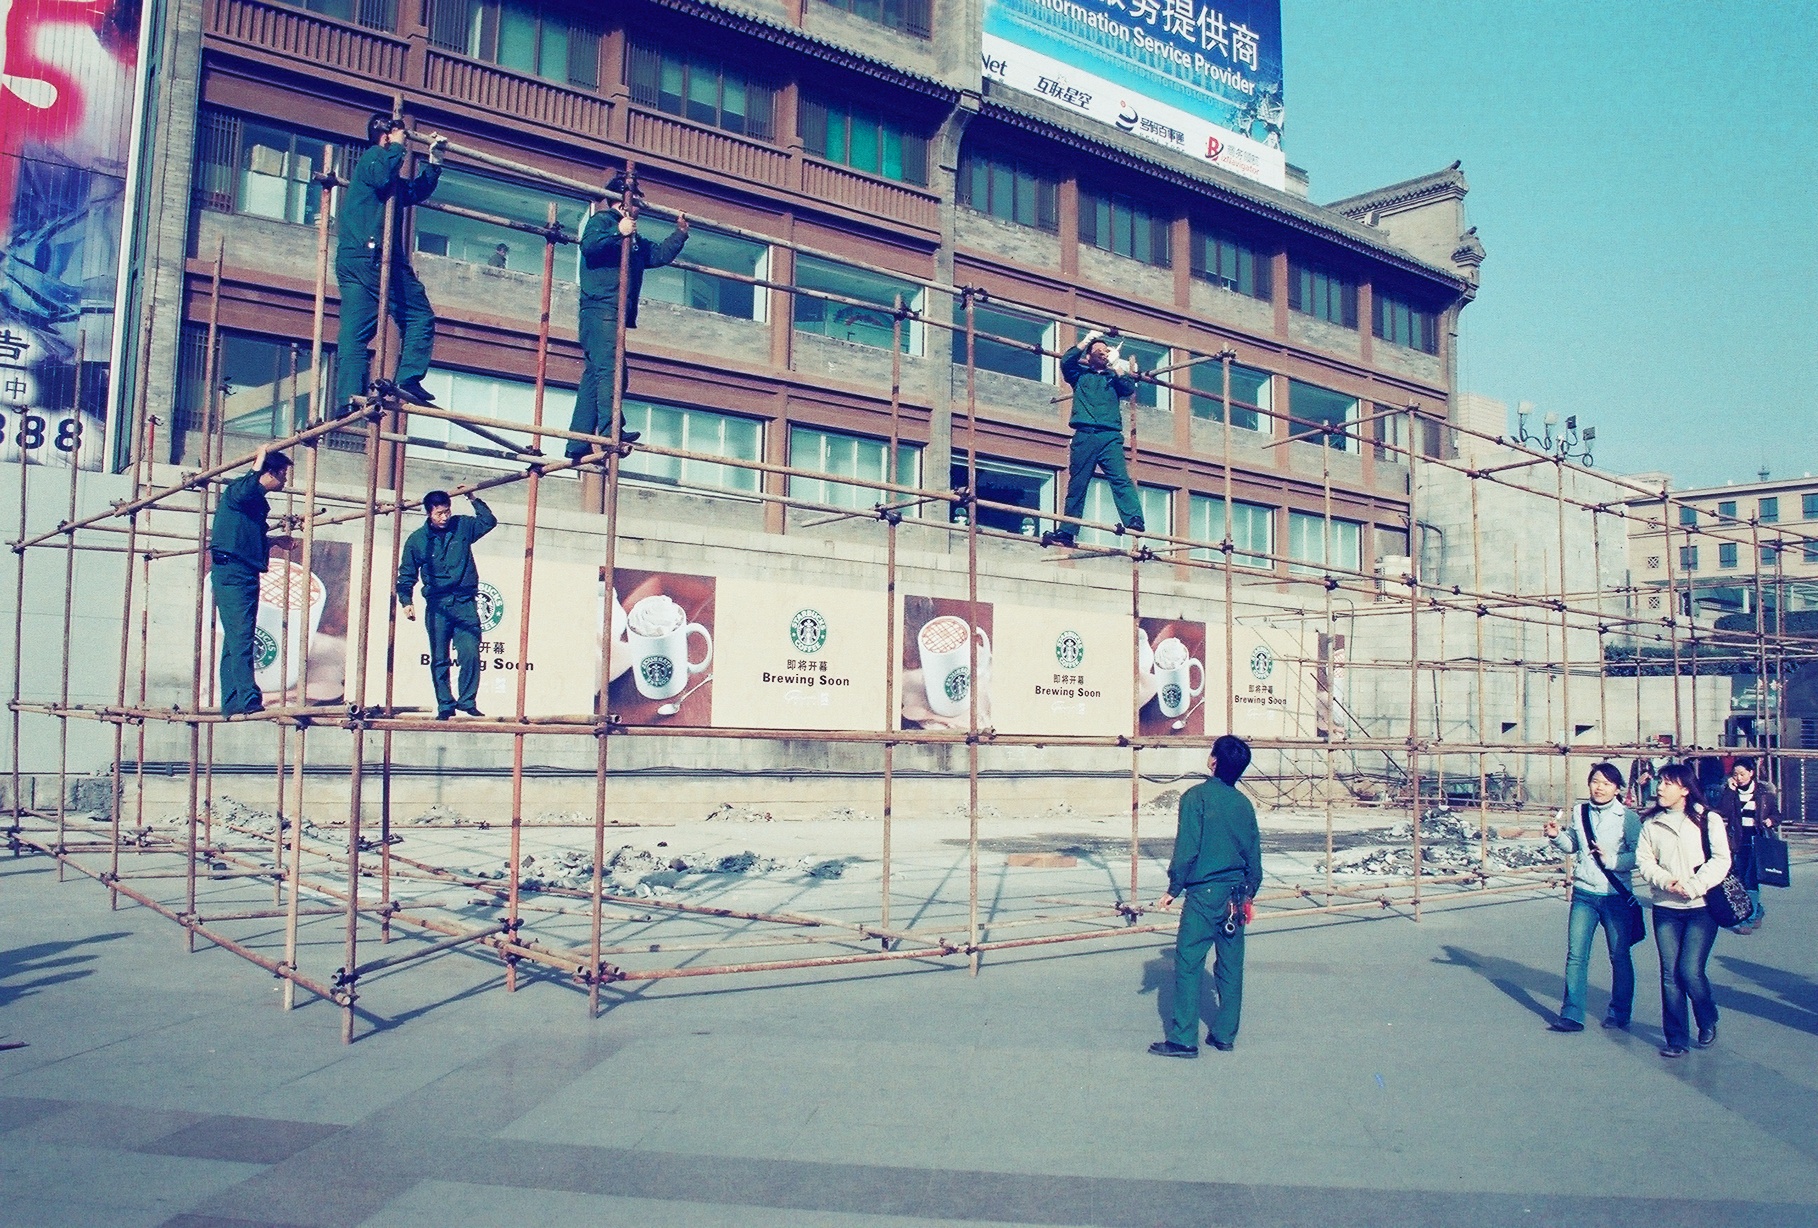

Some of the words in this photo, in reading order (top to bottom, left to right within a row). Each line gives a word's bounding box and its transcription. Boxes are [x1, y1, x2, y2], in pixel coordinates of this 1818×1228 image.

[1133, 26, 1192, 68] Service
[1195, 52, 1255, 96] Provider
[1033, 75, 1093, 110] 互联星空
[5, 377, 27, 400] 中
[790, 609, 827, 631] STARBUCKS
[794, 639, 822, 653] COFFEE
[787, 659, 828, 672] 即将开幕
[762, 672, 815, 687] Brewing
[819, 675, 850, 687] Soon
[1035, 685, 1075, 699] Brewing
[1077, 687, 1101, 698] Soon
[1234, 694, 1266, 706] Brewing
